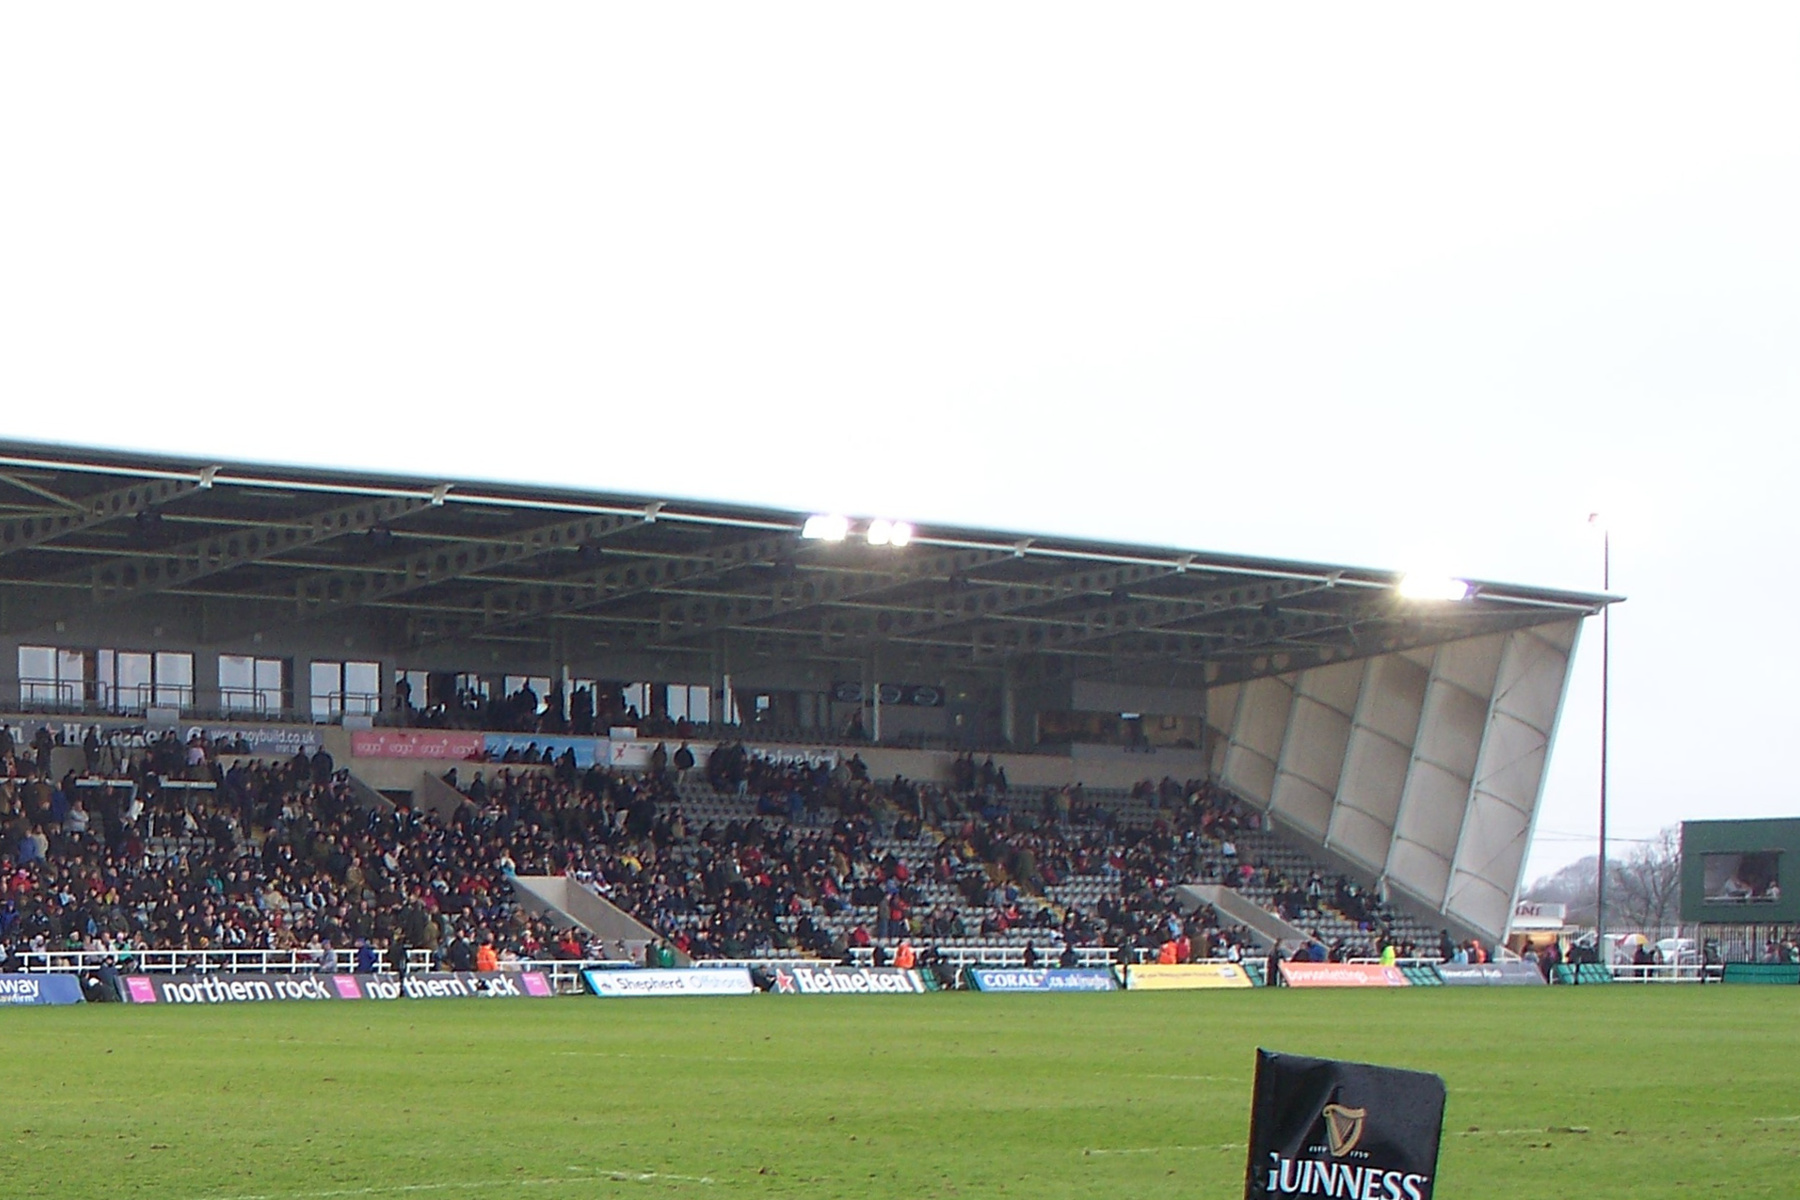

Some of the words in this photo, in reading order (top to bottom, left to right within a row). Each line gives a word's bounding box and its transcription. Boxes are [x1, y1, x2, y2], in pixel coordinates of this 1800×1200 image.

[162, 976, 274, 1003] northern
[274, 976, 331, 999] rock
[366, 975, 468, 999] northern
[616, 977, 685, 990] Shepherd
[793, 968, 914, 993] Heineken
[983, 974, 1039, 987] CORAL
